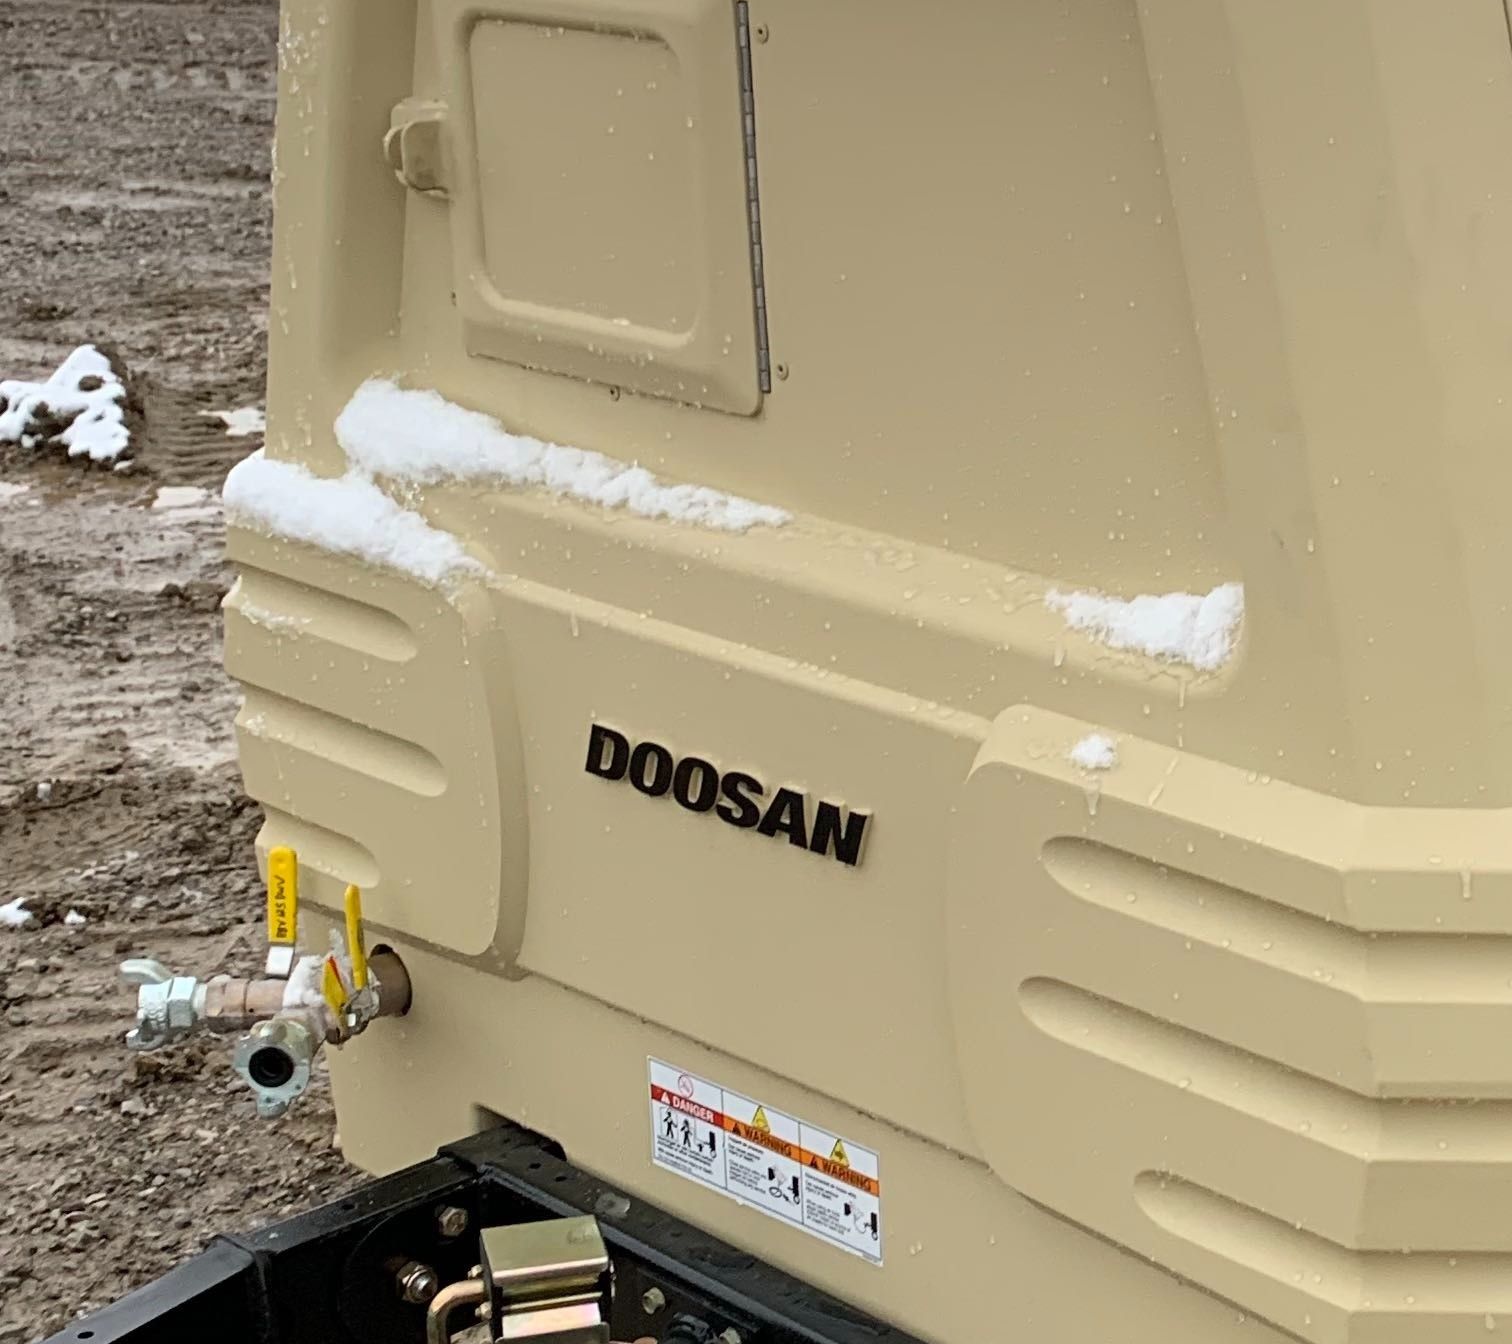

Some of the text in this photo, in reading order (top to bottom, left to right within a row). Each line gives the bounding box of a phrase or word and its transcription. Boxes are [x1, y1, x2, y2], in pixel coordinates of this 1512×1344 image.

[585, 722, 871, 868] DOOSAN
[672, 1095, 715, 1123] DANGER
[744, 1128, 792, 1157] WARNING
[822, 1160, 871, 1191] WARNING
